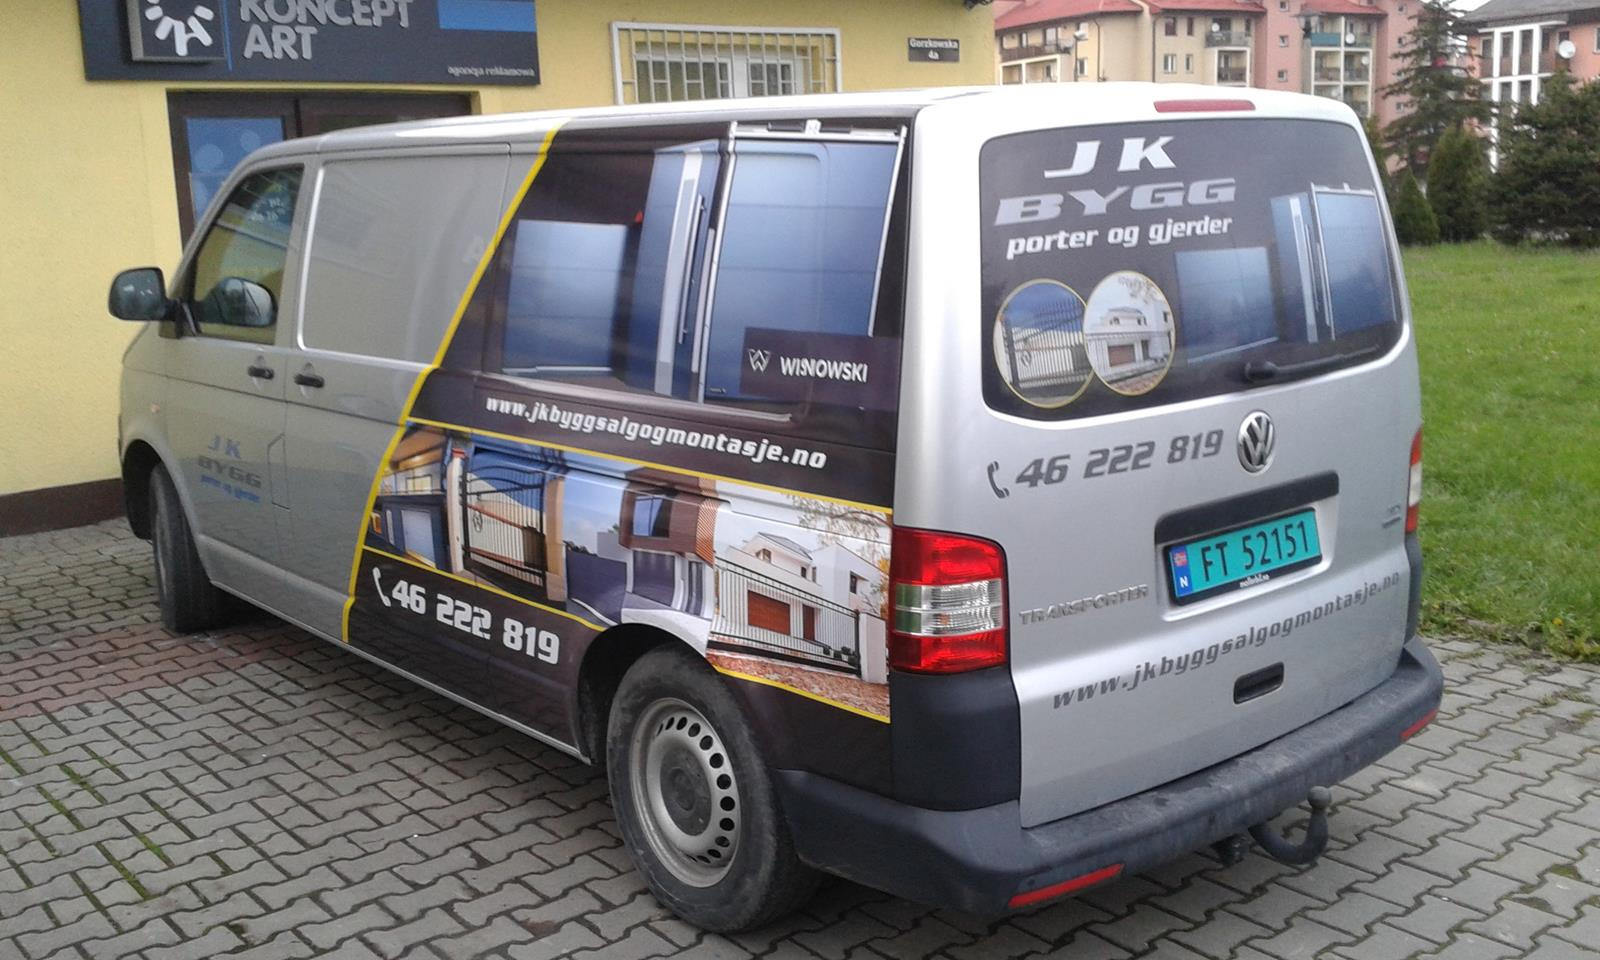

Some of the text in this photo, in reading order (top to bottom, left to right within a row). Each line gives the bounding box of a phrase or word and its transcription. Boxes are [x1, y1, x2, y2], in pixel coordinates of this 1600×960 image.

[240, 0, 415, 28] KONCEPT
[243, 24, 318, 60] ART
[993, 177, 1237, 226] BYGG
[1006, 215, 1233, 260] porter og gjerder
[486, 396, 827, 469] www.jkbyggsalgogmontasje.no
[1015, 429, 1224, 488] 46 222 819
[1201, 520, 1309, 582] FT 52151
[1019, 583, 1148, 625] TRANSPORTER
[1179, 575, 1189, 588] N
[392, 580, 560, 665] 46 222 819
[1053, 570, 1400, 709] www.jkbyggsalgogmontasje.no
